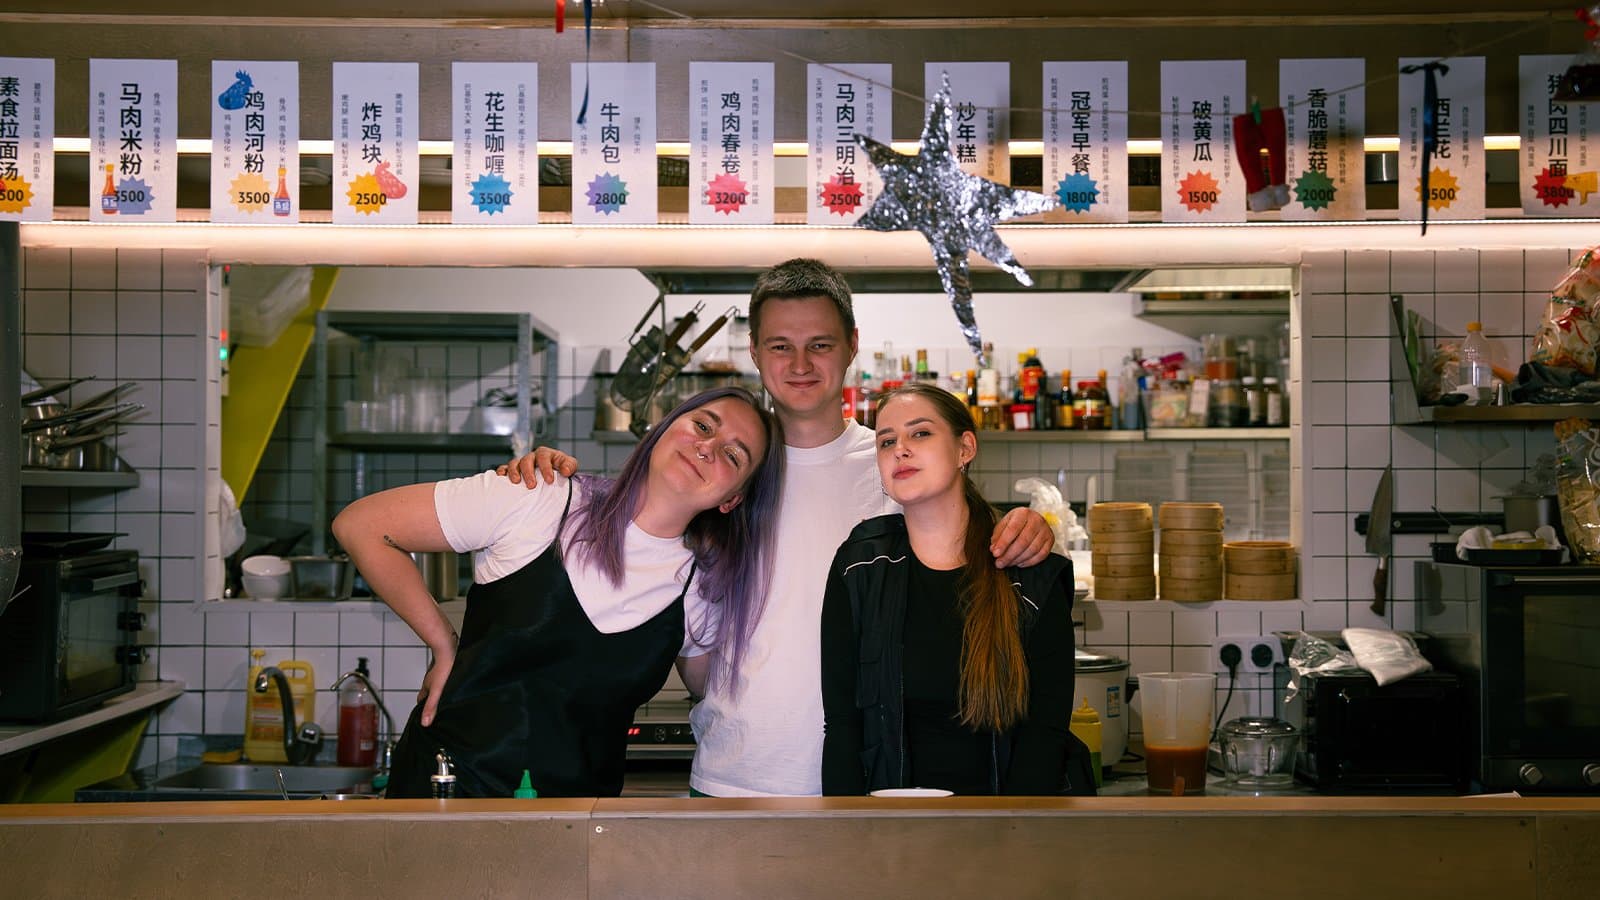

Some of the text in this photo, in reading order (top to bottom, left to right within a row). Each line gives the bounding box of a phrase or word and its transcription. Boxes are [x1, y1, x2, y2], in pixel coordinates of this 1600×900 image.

[0, 77, 19, 181] 素食拉面汤
[120, 83, 142, 175] 马肉米粉
[245, 91, 265, 173] 鸡肉河粉
[362, 102, 382, 164] 炸鸡块
[485, 91, 505, 174] 花生咖喱
[601, 103, 621, 163] 牛肉包
[721, 92, 741, 174] 鸡肉春卷
[836, 83, 855, 186] 马肉三明治
[956, 102, 977, 163] 炒年糕
[1071, 91, 1091, 173] 冠军早餐
[1192, 100, 1212, 161] 破黄瓜
[1308, 88, 1328, 171] 香脆蘑菇
[114, 190, 145, 202] 3500
[239, 191, 270, 203] 3500
[356, 193, 387, 205] 2500
[480, 193, 510, 204] 3500
[595, 193, 626, 204] 2800
[715, 192, 746, 204] 3200
[830, 194, 861, 205] 2500
[1067, 192, 1096, 204] 1800
[1188, 191, 1217, 204] 1500
[1303, 189, 1334, 201] 2000
[1427, 188, 1455, 200] 500
